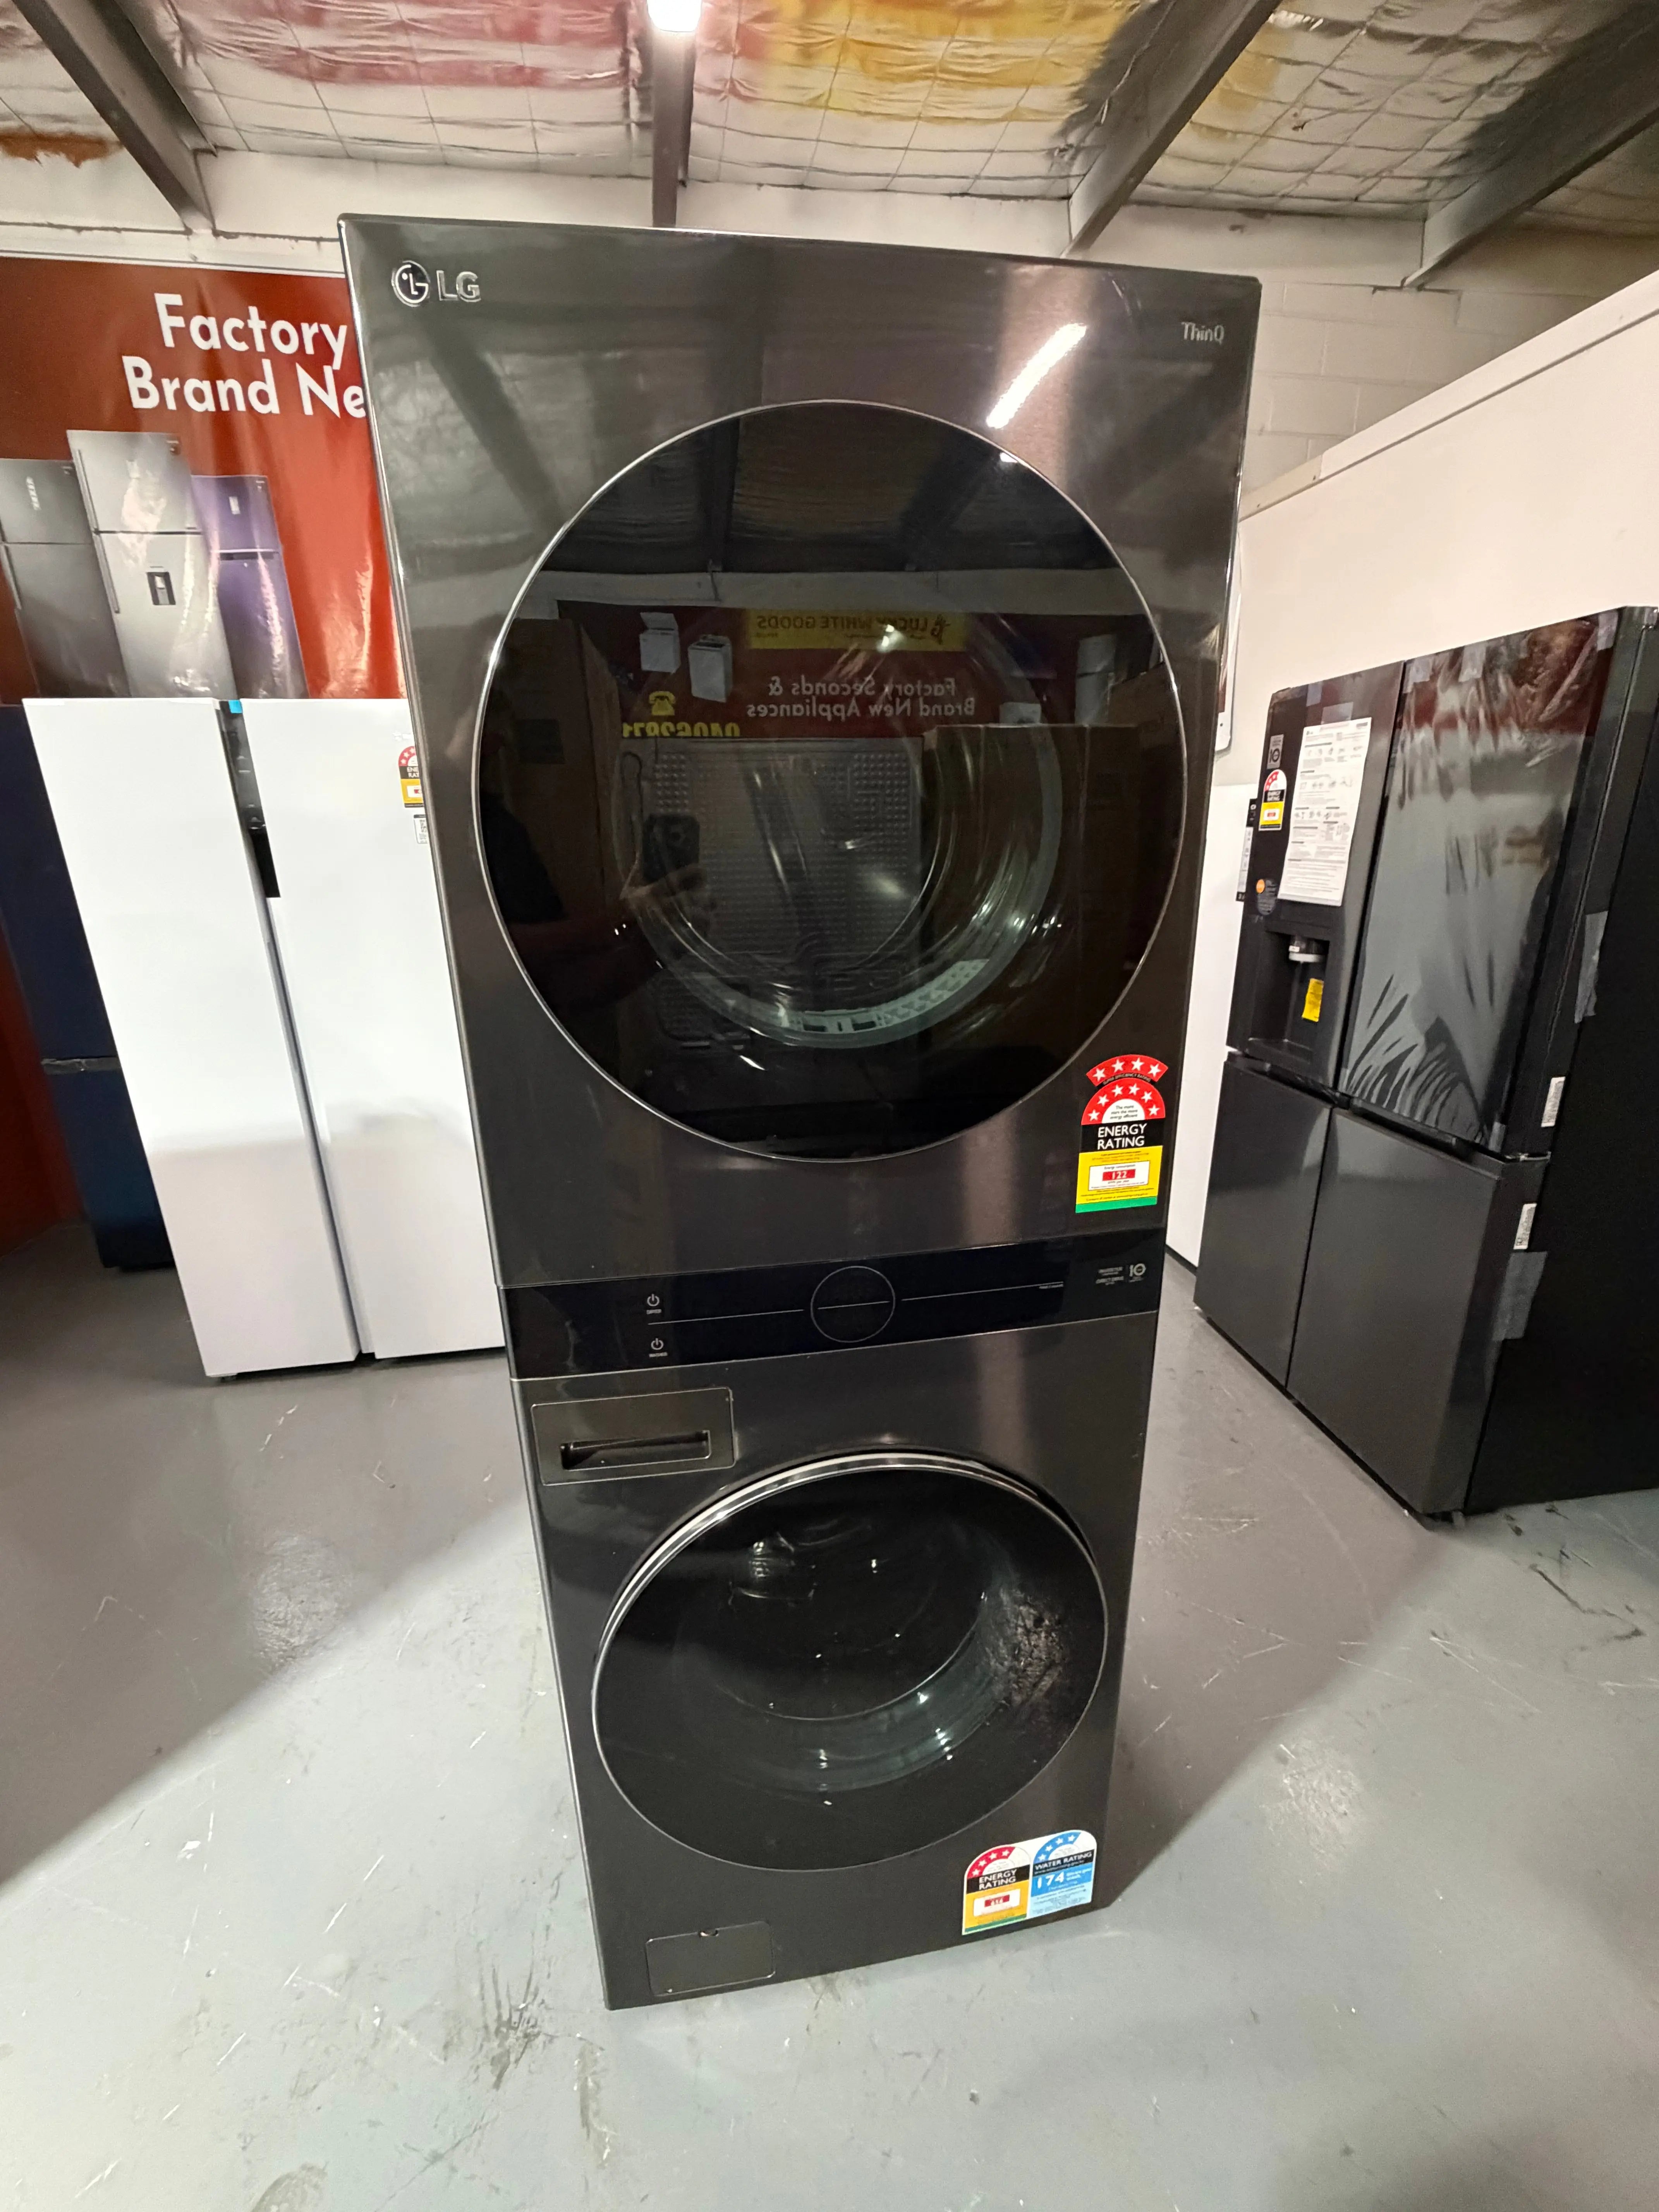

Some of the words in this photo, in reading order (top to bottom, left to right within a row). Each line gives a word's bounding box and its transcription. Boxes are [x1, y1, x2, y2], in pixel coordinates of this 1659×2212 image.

[438, 271, 481, 302] LG
[154, 292, 347, 371] Factory
[1181, 322, 1225, 345] ThinQ
[122, 356, 280, 414] Brand
[1097, 1123, 1147, 1138] ENERGY
[1097, 1135, 1145, 1150] RATING
[1112, 1171, 1127, 1180] 122
[1035, 1859, 1061, 1870] WATER
[1063, 1851, 1092, 1863] RATING
[979, 1869, 1017, 1883] ENERGY
[979, 1876, 1016, 1890] RATING
[1037, 1871, 1065, 1889] 174
